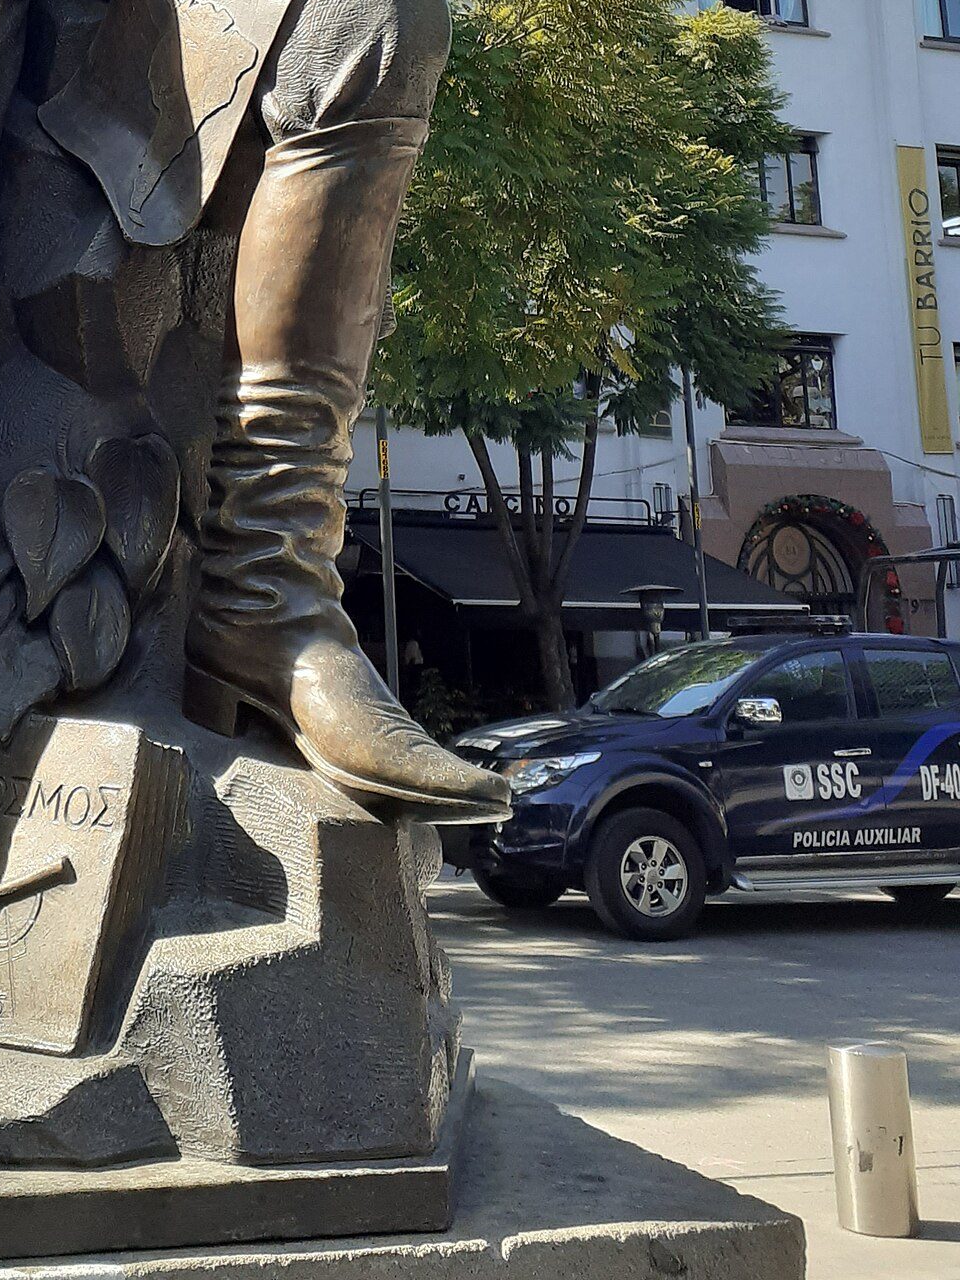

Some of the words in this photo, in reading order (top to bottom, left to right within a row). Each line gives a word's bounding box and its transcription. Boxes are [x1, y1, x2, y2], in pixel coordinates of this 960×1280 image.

[908, 188, 938, 310] BARRIO
[918, 325, 943, 366] TU
[817, 761, 862, 800] SSC
[793, 830, 851, 848] POLICIA
[854, 827, 921, 845] AUXILIAR
